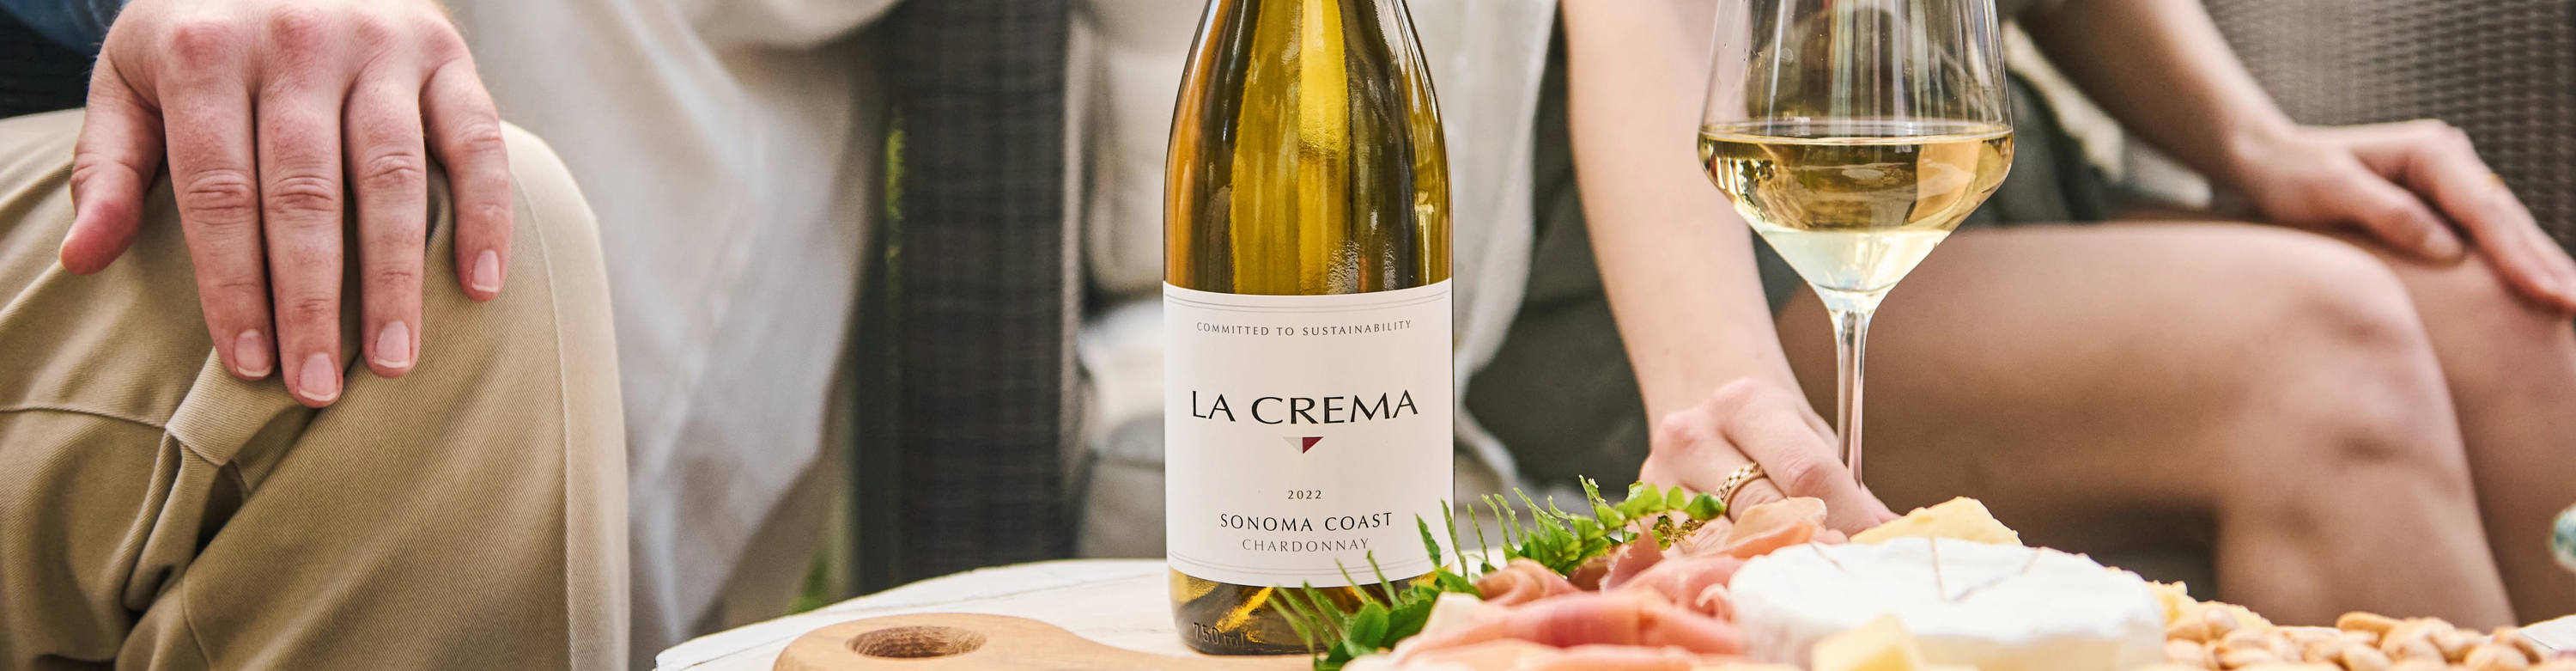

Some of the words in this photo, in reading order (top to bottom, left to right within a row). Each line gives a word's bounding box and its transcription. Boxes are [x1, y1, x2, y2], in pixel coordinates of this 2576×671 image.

[1196, 321, 1269, 336] COMMITTED
[1276, 326, 1295, 337] TO
[1303, 320, 1412, 337] SUSTAINABILITY
[1192, 390, 1236, 423] LA
[1251, 389, 1419, 424] CREMA
[1287, 490, 1322, 500] 2022
[1220, 513, 1313, 532] SONOMA
[1324, 512, 1393, 531] COAST
[1242, 538, 1369, 553] CHARDONNAY
[1193, 622, 1219, 645] 750
